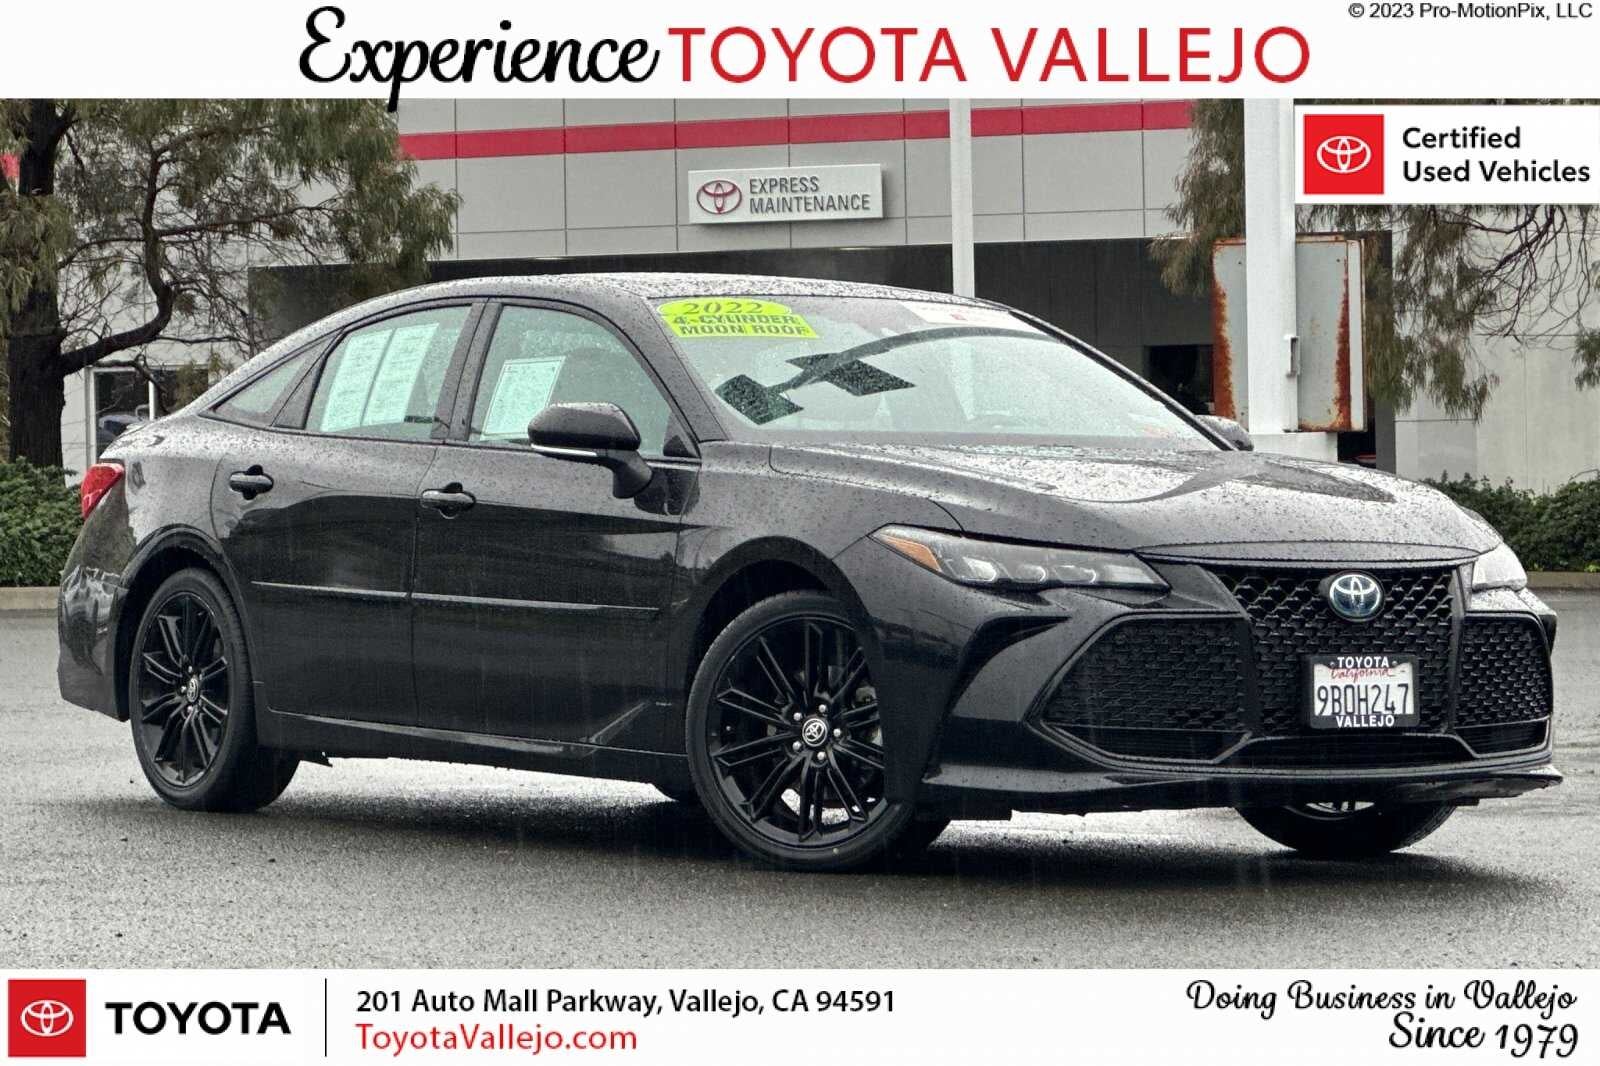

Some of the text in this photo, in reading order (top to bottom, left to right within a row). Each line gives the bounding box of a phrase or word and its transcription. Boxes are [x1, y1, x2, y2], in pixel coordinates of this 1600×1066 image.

[749, 176, 820, 194] EXPRESS
[749, 193, 871, 214] MAINTENANCE
[682, 301, 763, 315] 2022
[680, 324, 810, 335] MOON ROOF
[1337, 656, 1389, 669] TOYOTA
[1336, 715, 1395, 728] VALLEJO
